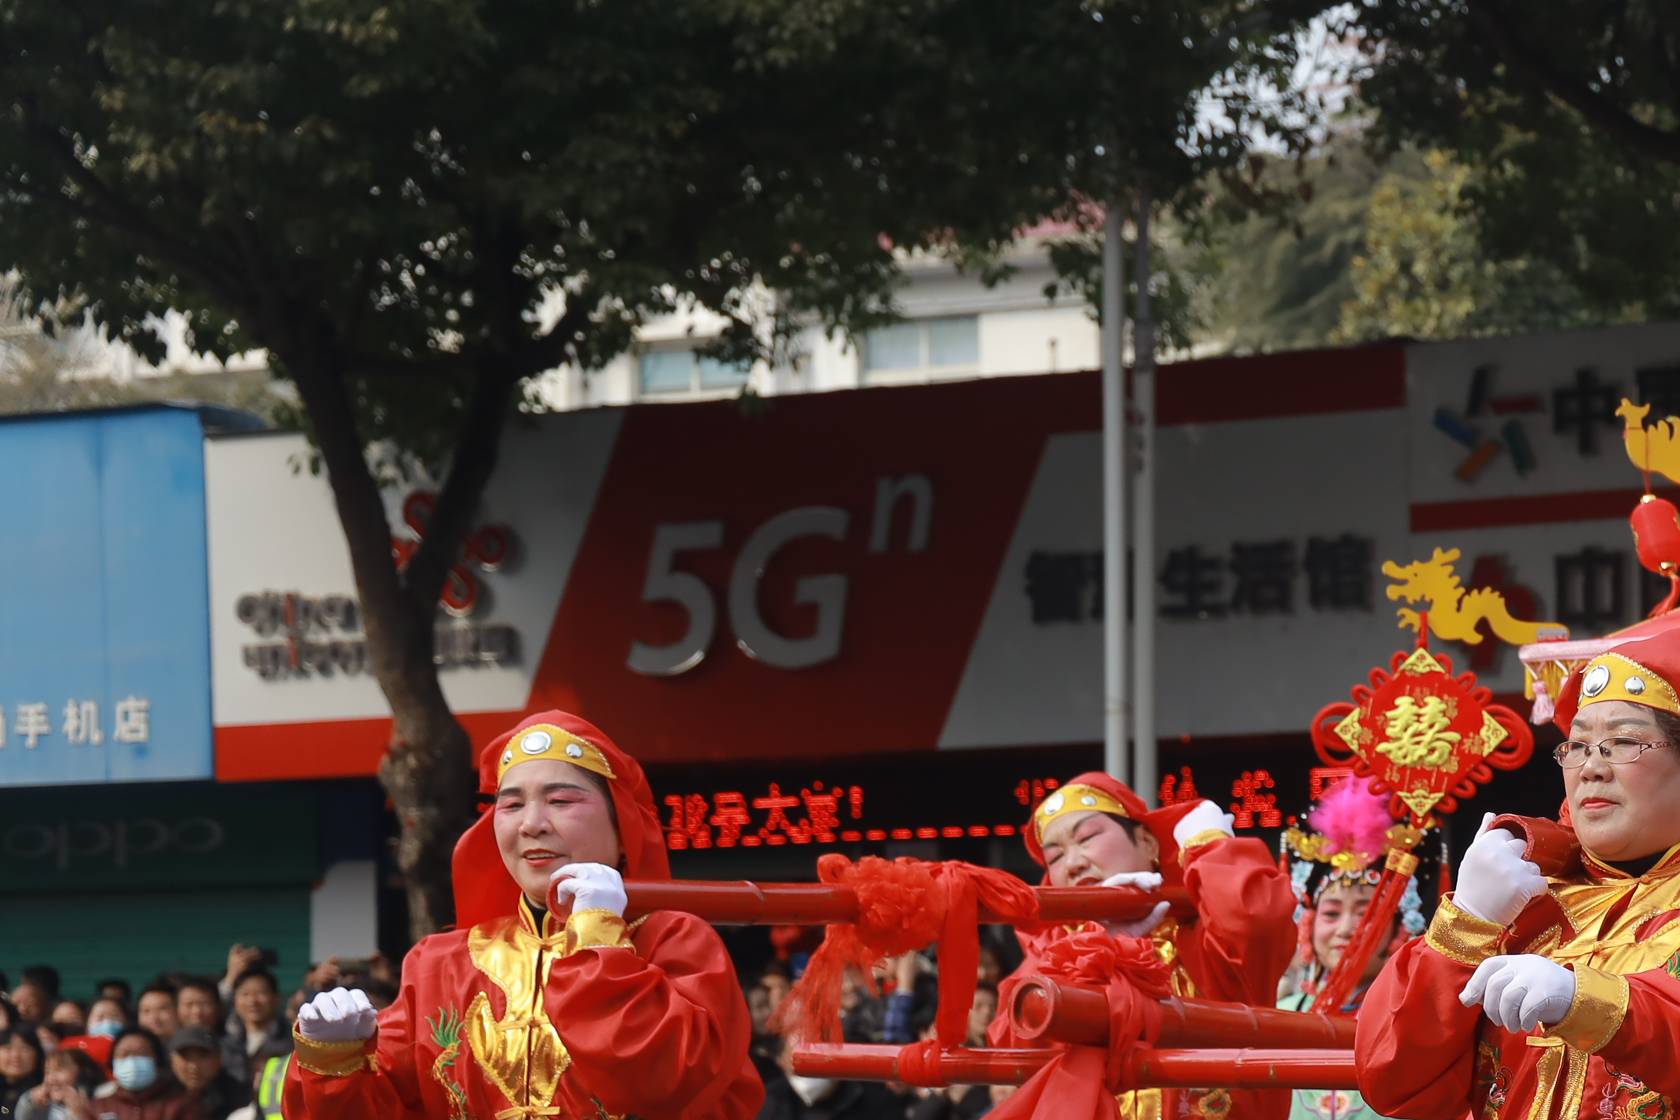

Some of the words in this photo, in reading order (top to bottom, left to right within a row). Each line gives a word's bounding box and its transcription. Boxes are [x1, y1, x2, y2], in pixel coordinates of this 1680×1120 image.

[1025, 533, 1375, 626] 智生活馆
[0, 697, 151, 749] 手机店
